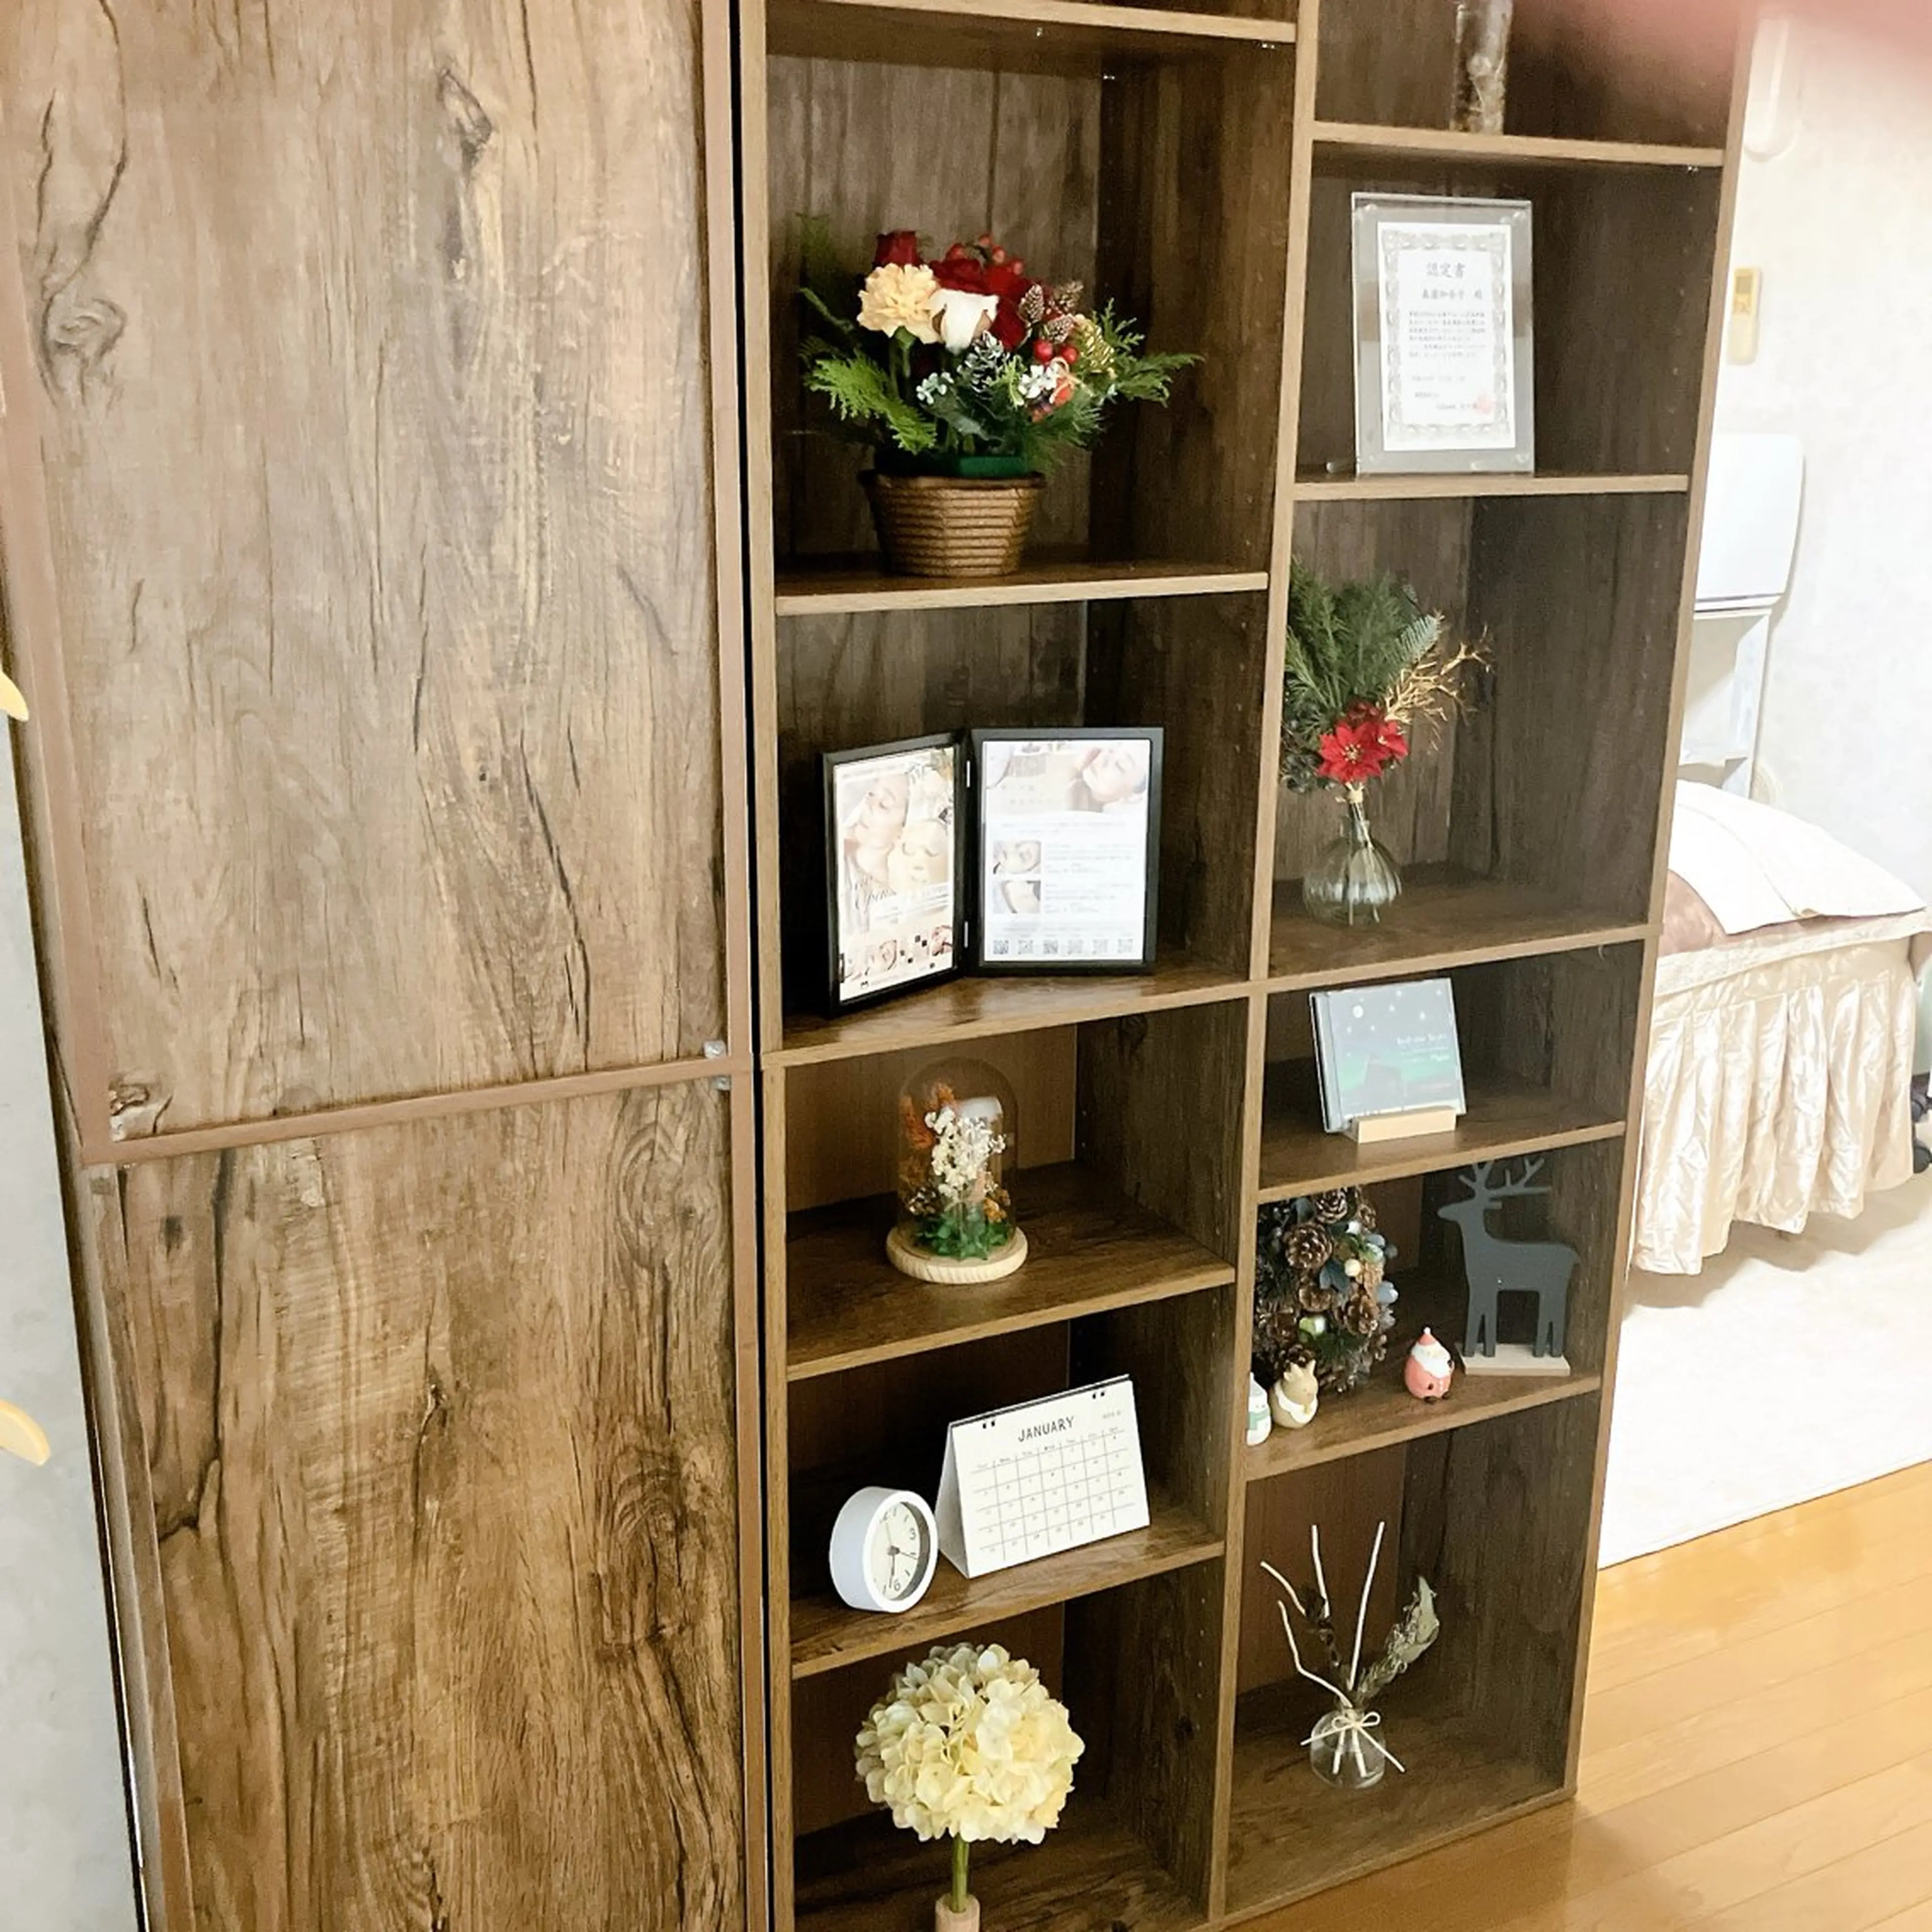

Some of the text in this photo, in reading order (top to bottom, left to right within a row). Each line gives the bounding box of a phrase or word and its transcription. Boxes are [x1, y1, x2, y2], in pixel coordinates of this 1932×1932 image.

[1018, 1416, 1075, 1442] JANUARY
[910, 1527, 917, 1540] 3
[894, 1578, 901, 1591] 6
